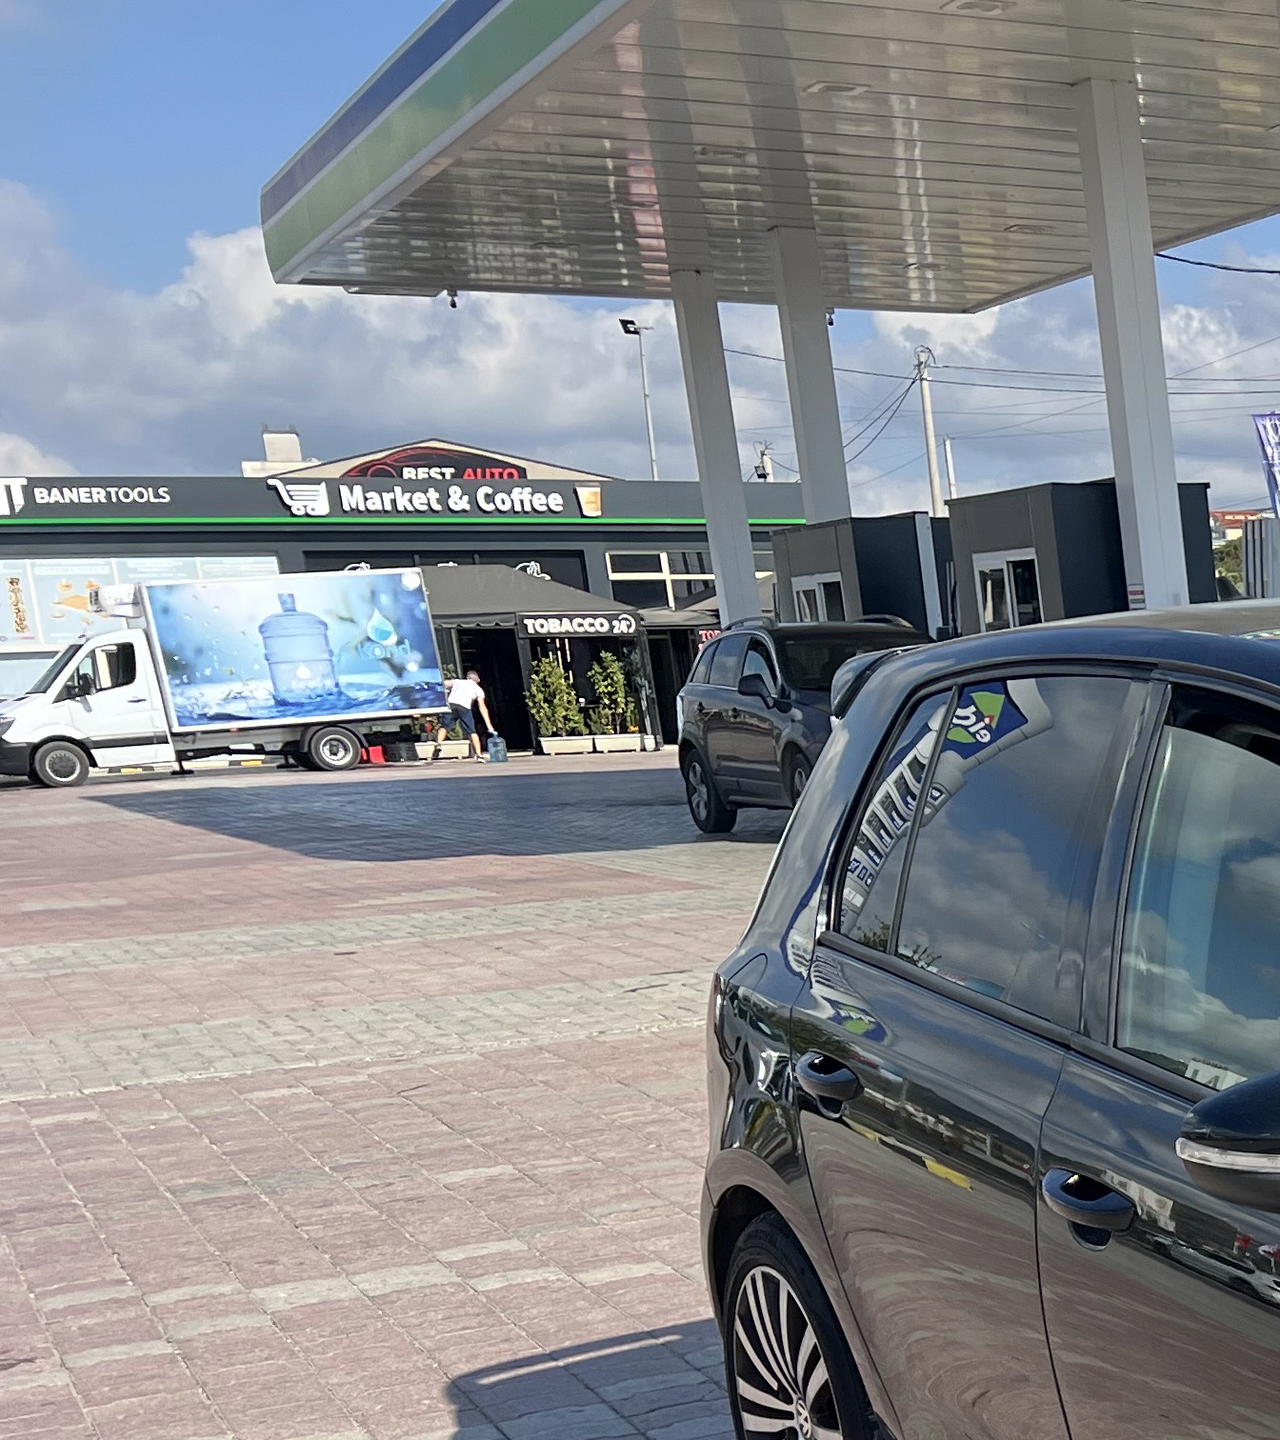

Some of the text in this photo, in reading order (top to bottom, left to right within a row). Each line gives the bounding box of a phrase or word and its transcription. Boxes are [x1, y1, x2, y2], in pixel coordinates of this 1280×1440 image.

[402, 466, 520, 480] BEST AUTO
[33, 487, 171, 504] BANERTOOLS
[340, 484, 564, 512] Market & Coffee
[523, 616, 610, 634] TOBACCO
